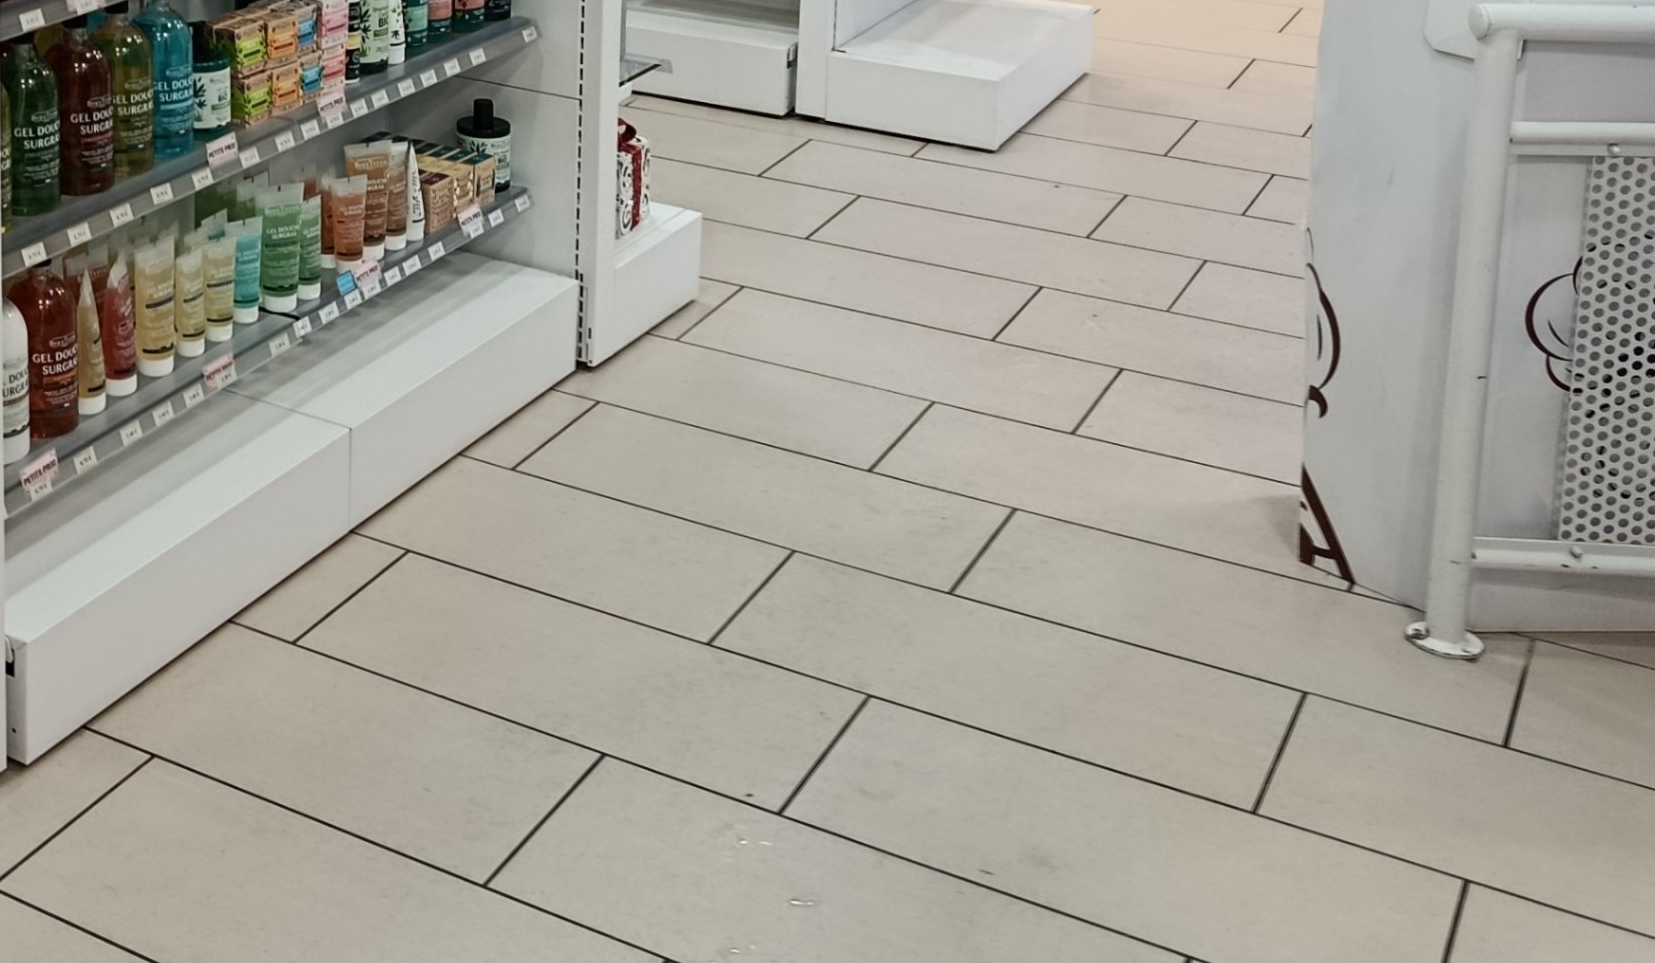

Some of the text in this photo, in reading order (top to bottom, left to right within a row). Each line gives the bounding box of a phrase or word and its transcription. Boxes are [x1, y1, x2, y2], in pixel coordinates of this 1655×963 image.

[171, 76, 194, 89] DOUC
[70, 113, 93, 124] GEL
[14, 127, 35, 138] GEL
[32, 352, 53, 365] GEL
